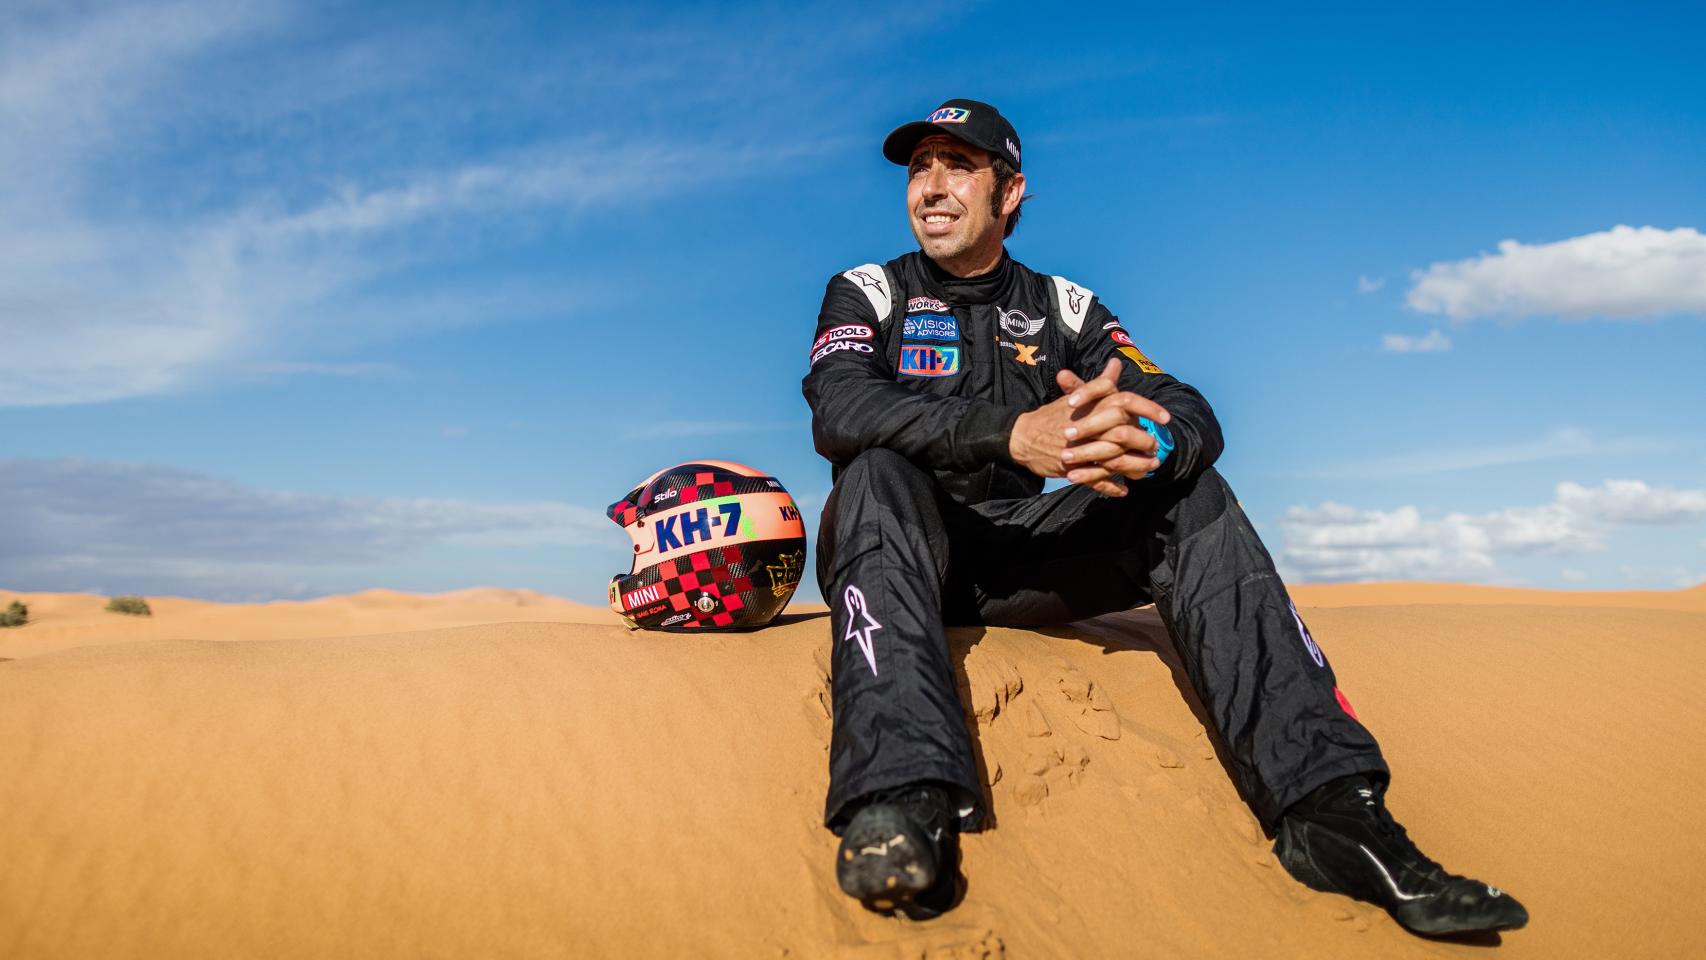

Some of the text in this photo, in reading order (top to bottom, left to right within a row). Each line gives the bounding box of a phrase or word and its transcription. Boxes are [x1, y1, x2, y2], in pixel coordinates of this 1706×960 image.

[906, 301, 940, 311] WORKS
[913, 318, 956, 330] VISION
[1006, 317, 1028, 330] MINI
[829, 327, 867, 339] TOOLS
[917, 329, 956, 338] ADVISORS
[901, 349, 955, 370] KH-7
[655, 502, 742, 554] KH-7
[627, 585, 660, 608] MINI
